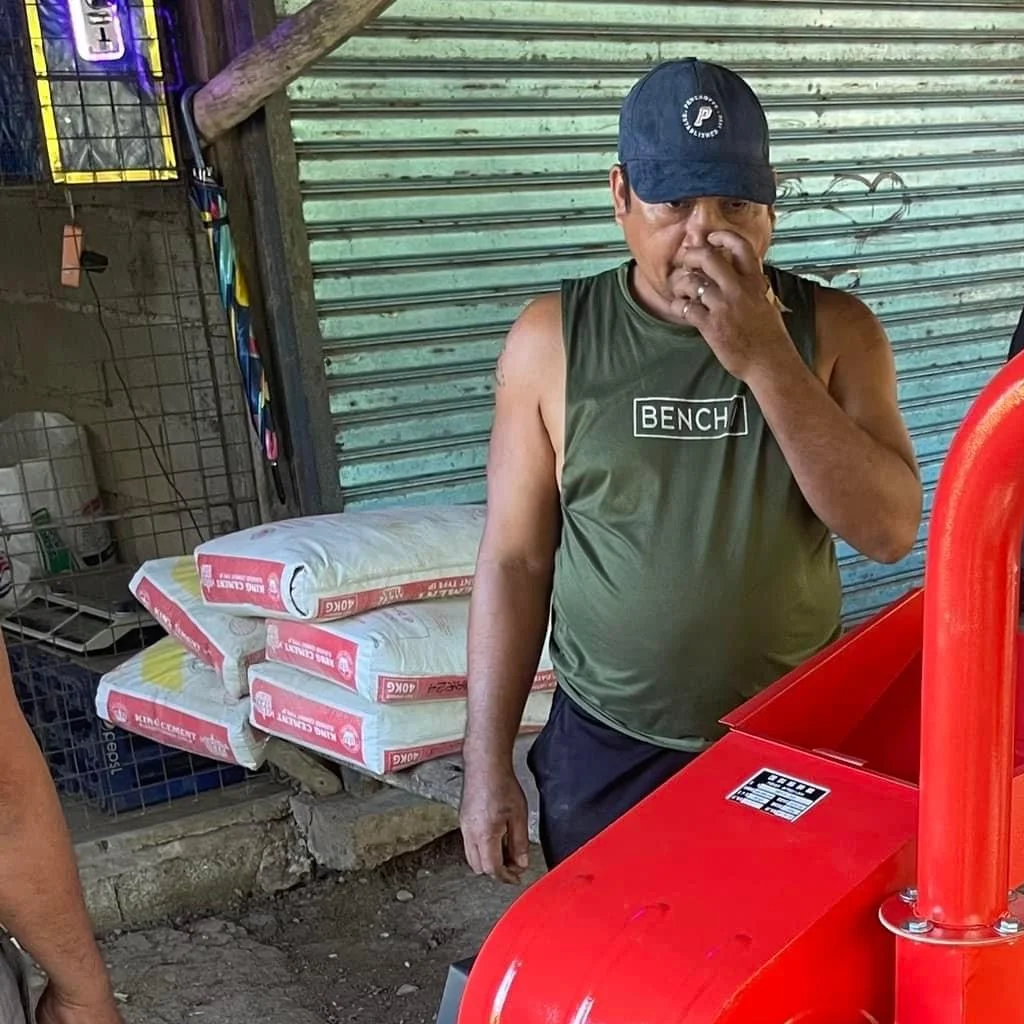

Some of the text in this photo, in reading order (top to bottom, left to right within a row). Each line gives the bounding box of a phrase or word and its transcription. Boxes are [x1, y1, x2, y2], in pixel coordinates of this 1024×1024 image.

[693, 106, 713, 127] P
[325, 599, 355, 613] 40KG
[386, 681, 416, 694] 40KG
[392, 751, 419, 765] 40KG
